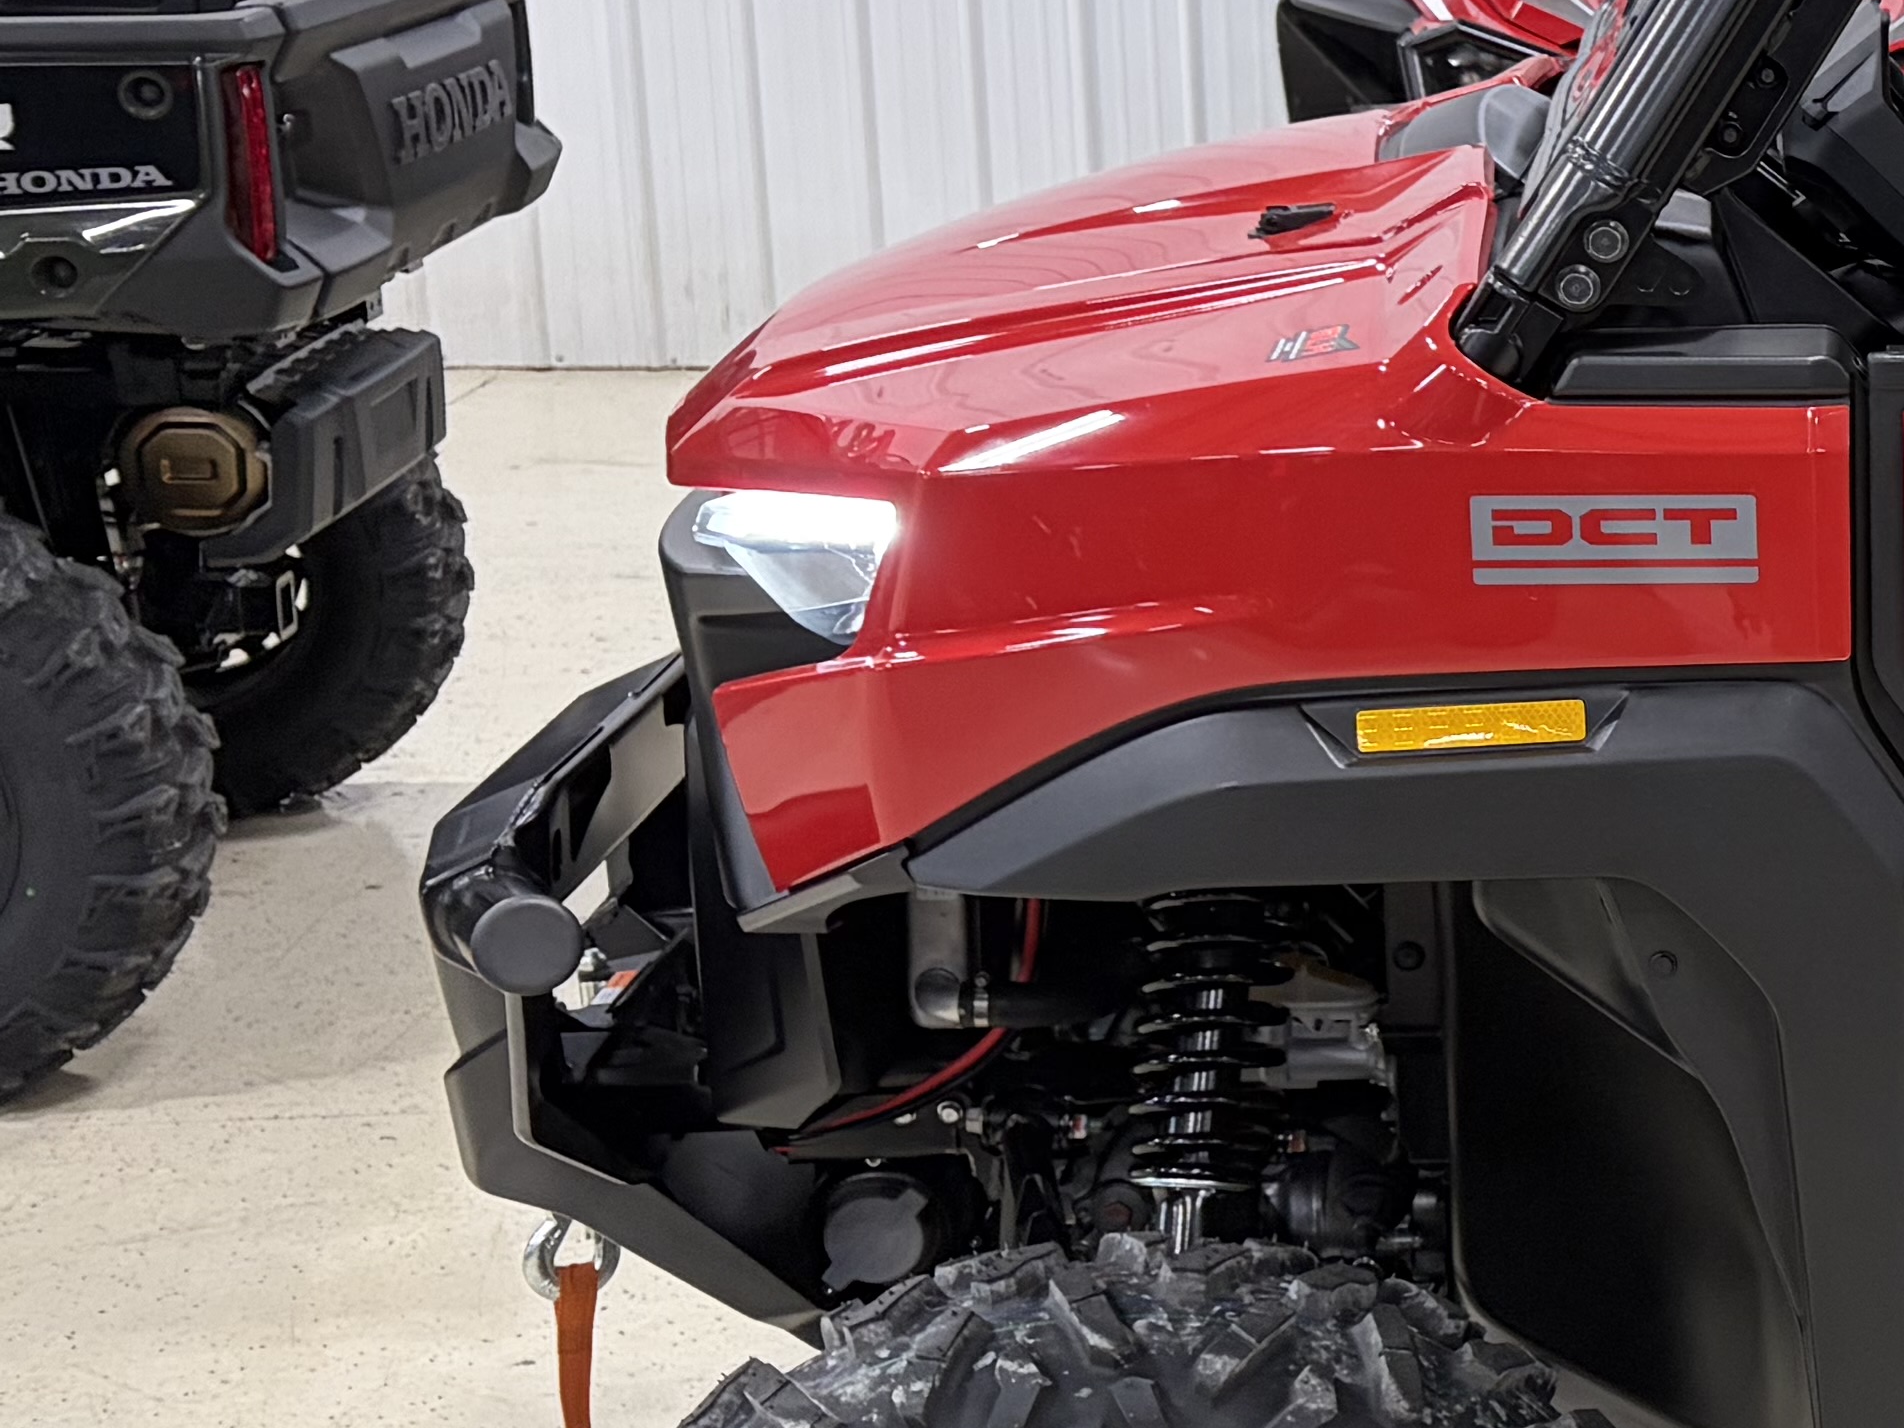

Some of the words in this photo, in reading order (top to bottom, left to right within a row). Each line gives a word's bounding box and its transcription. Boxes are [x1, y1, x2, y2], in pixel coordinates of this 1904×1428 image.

[391, 59, 512, 165] HONDA
[0, 165, 173, 194] HONDA
[1490, 507, 1738, 547] DCT
